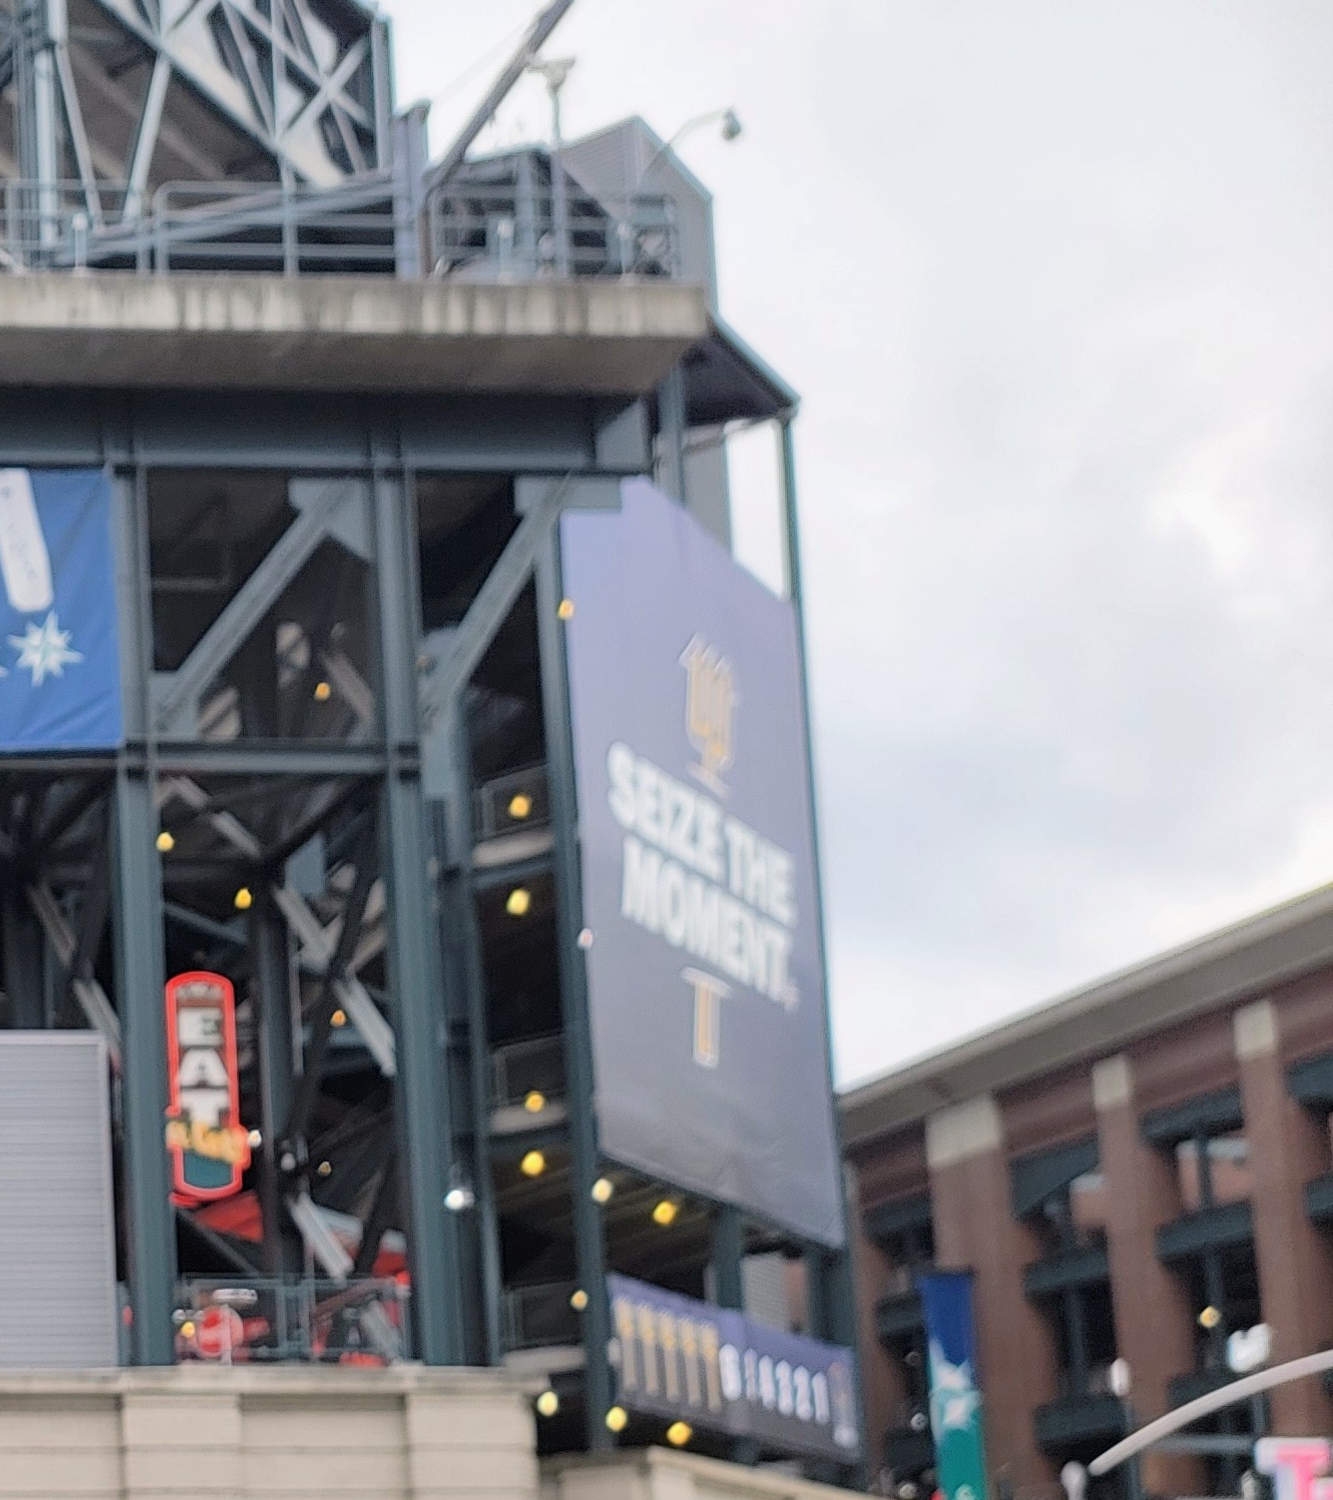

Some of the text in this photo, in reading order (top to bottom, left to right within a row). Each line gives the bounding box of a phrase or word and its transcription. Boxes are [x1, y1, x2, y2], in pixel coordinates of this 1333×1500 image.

[607, 739, 797, 929] SEIZE THE
[177, 1006, 230, 1130] EAT
